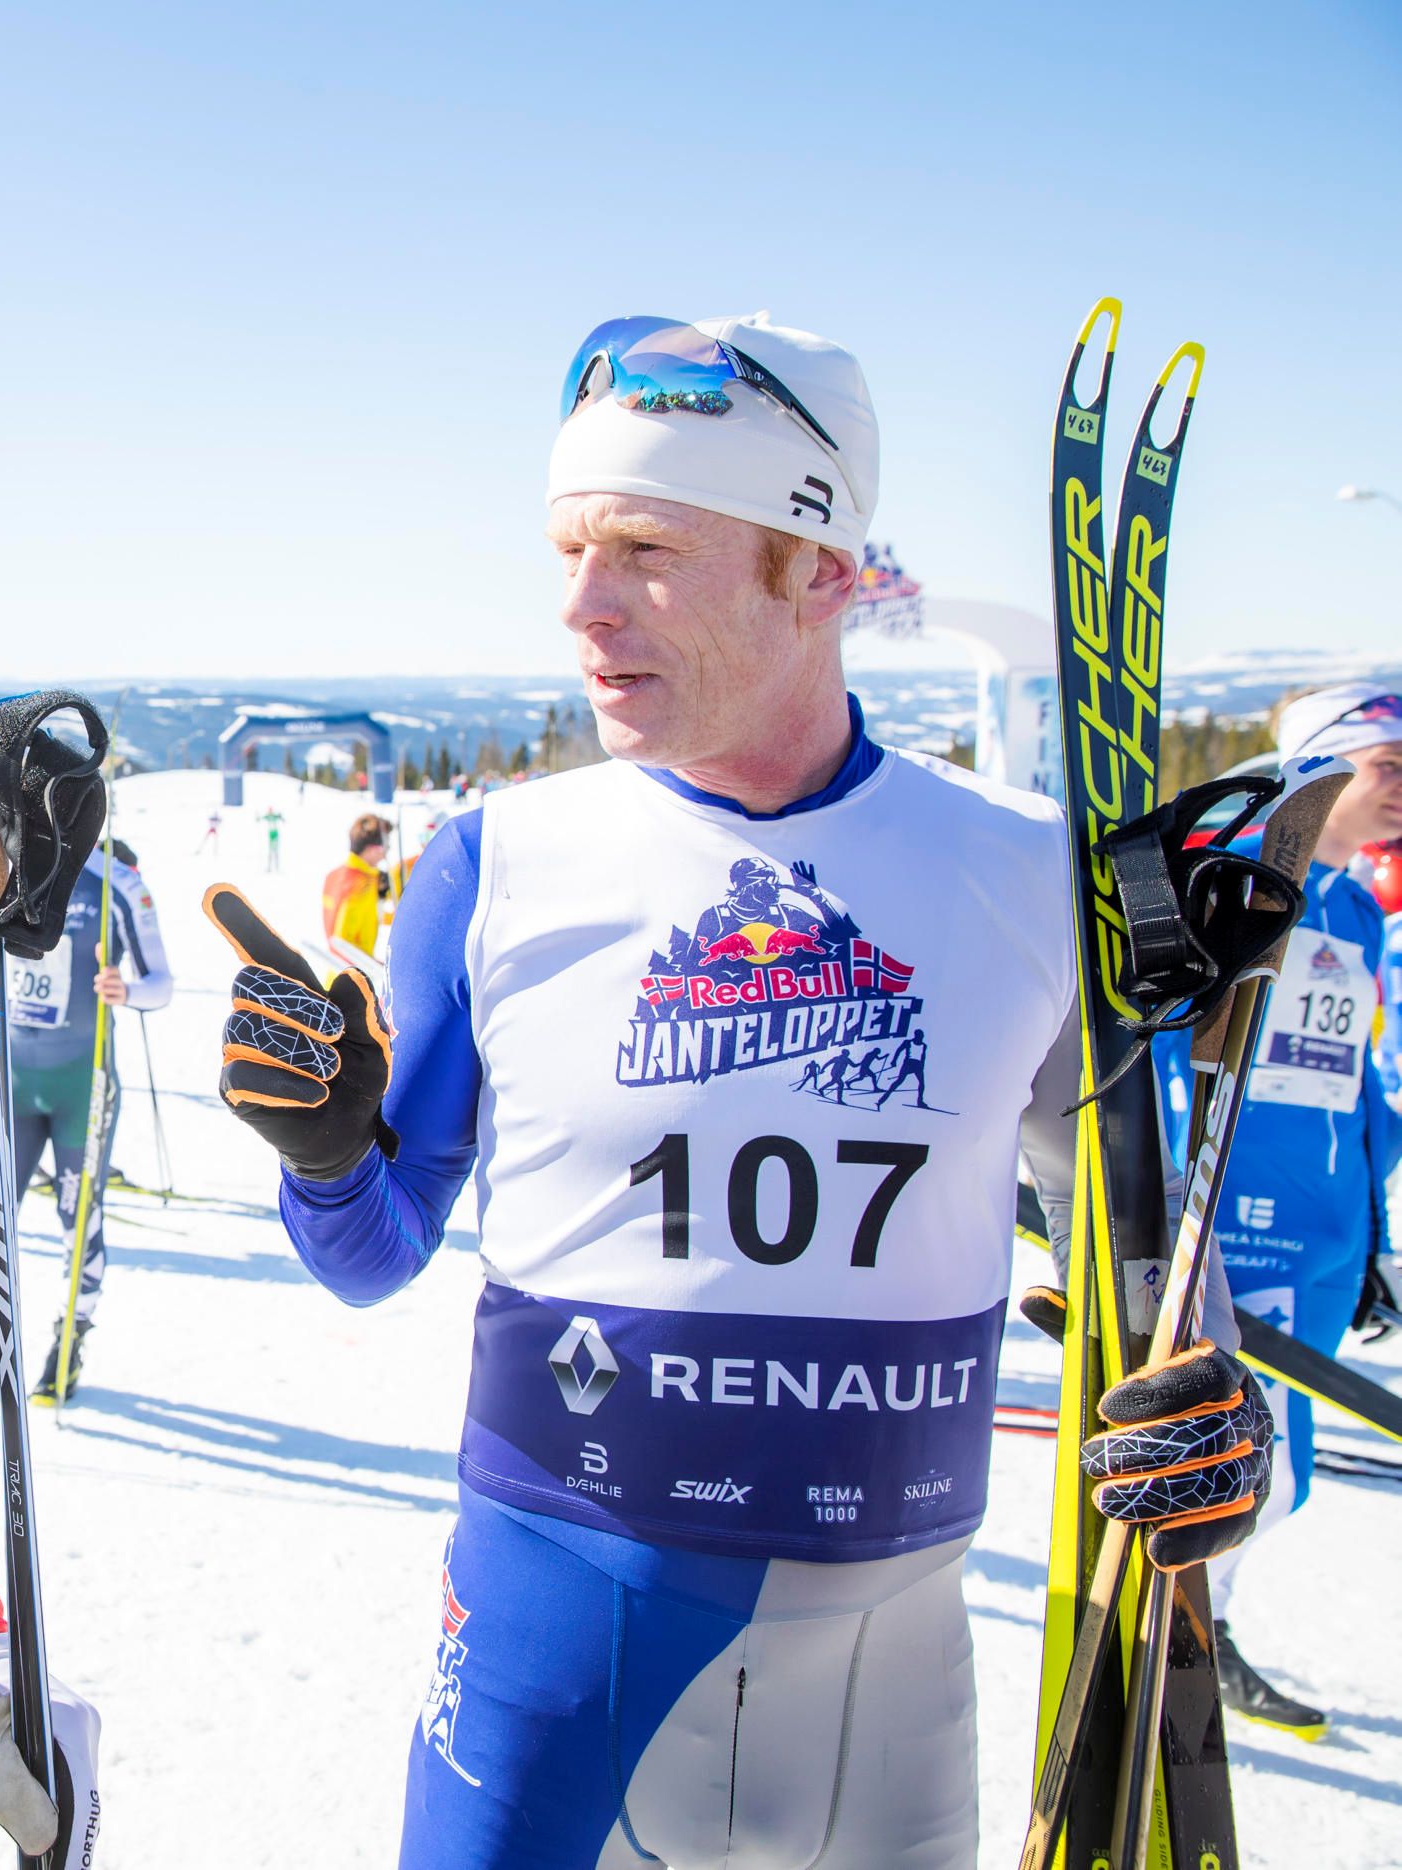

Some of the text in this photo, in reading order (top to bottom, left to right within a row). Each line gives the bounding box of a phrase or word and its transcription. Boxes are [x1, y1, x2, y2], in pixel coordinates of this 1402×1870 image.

[690, 961, 846, 1009] Red Bull
[1299, 991, 1355, 1035] 138
[619, 998, 917, 1086] JANTELOPPET
[629, 1132, 929, 1268] 107
[650, 1353, 977, 1411] RENAULT
[807, 1486, 864, 1502] REMA
[903, 1477, 954, 1501] SKILINE
[815, 1506, 857, 1521] 1000
[80, 1789, 101, 1870] ORTHUG
